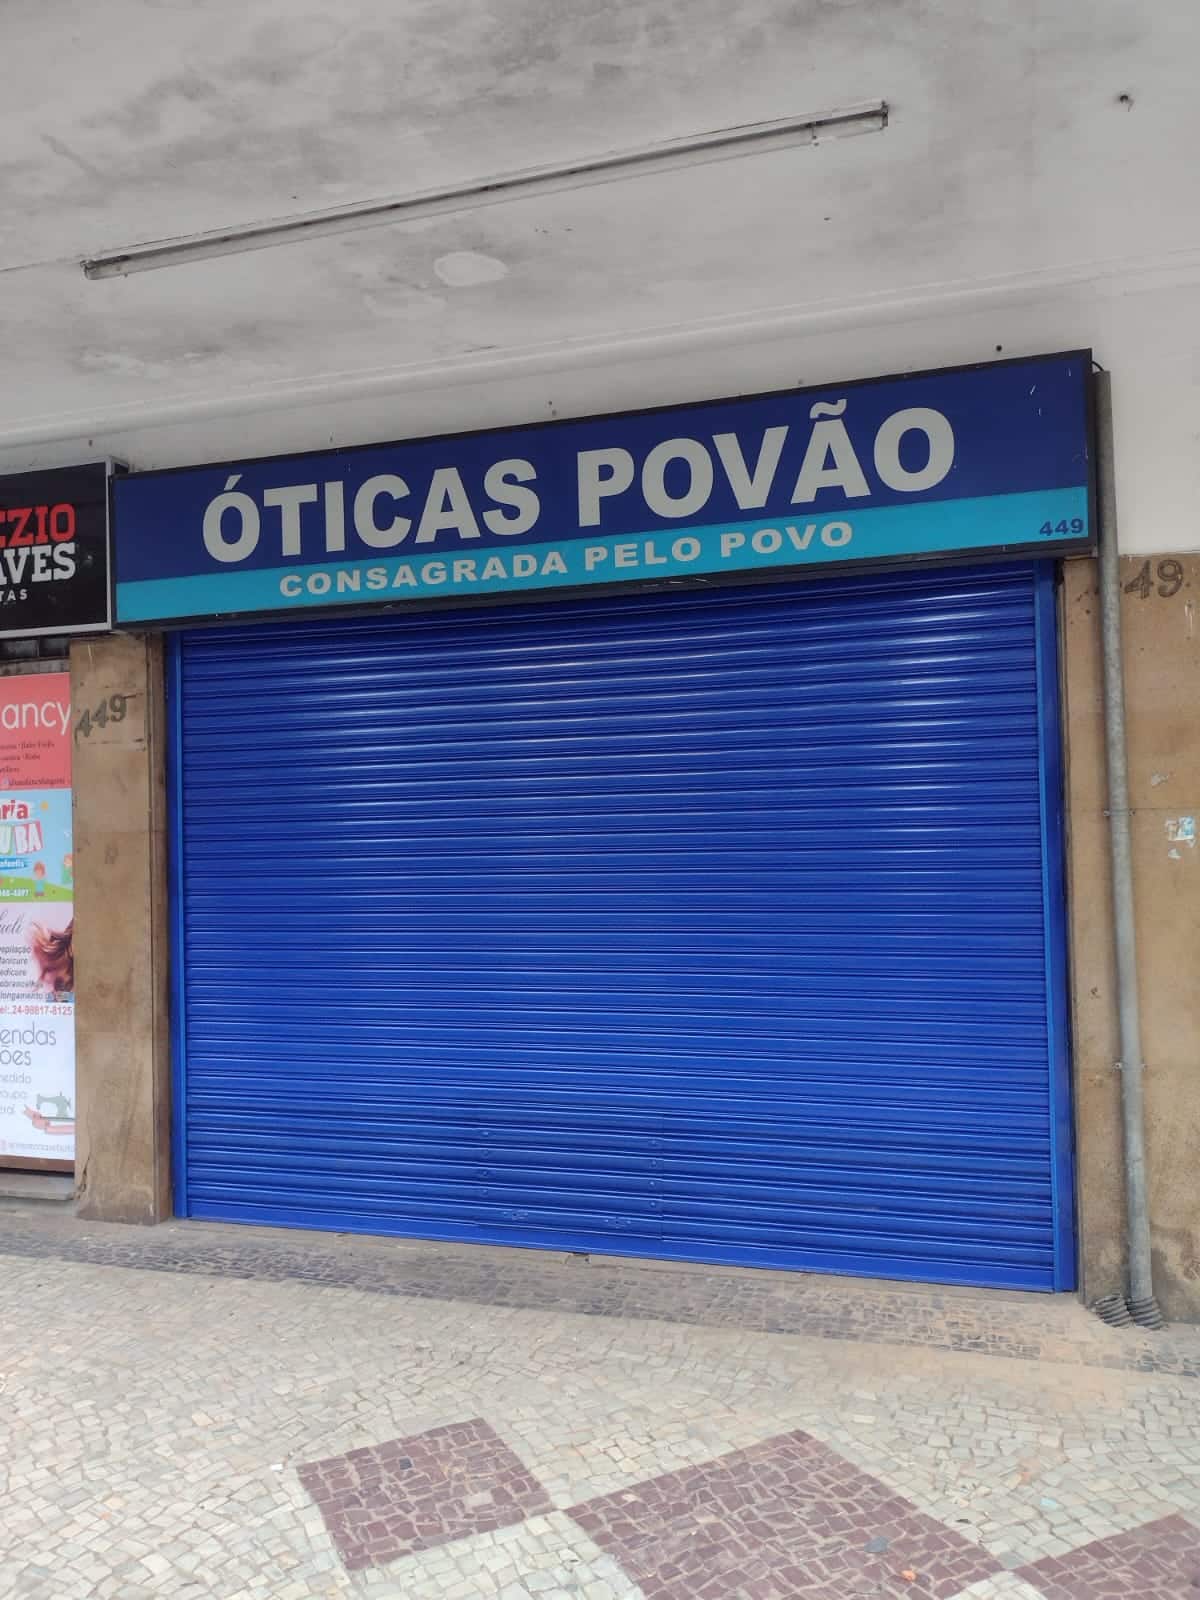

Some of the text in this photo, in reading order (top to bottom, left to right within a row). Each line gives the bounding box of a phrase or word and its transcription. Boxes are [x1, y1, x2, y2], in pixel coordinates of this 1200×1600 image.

[202, 398, 955, 563] ÓTICAS POVÃO
[1039, 518, 1084, 537] 449
[279, 521, 853, 598] CONSAGRADA PELO POVO
[1, 701, 72, 736] ancy
[75, 693, 128, 739] 449
